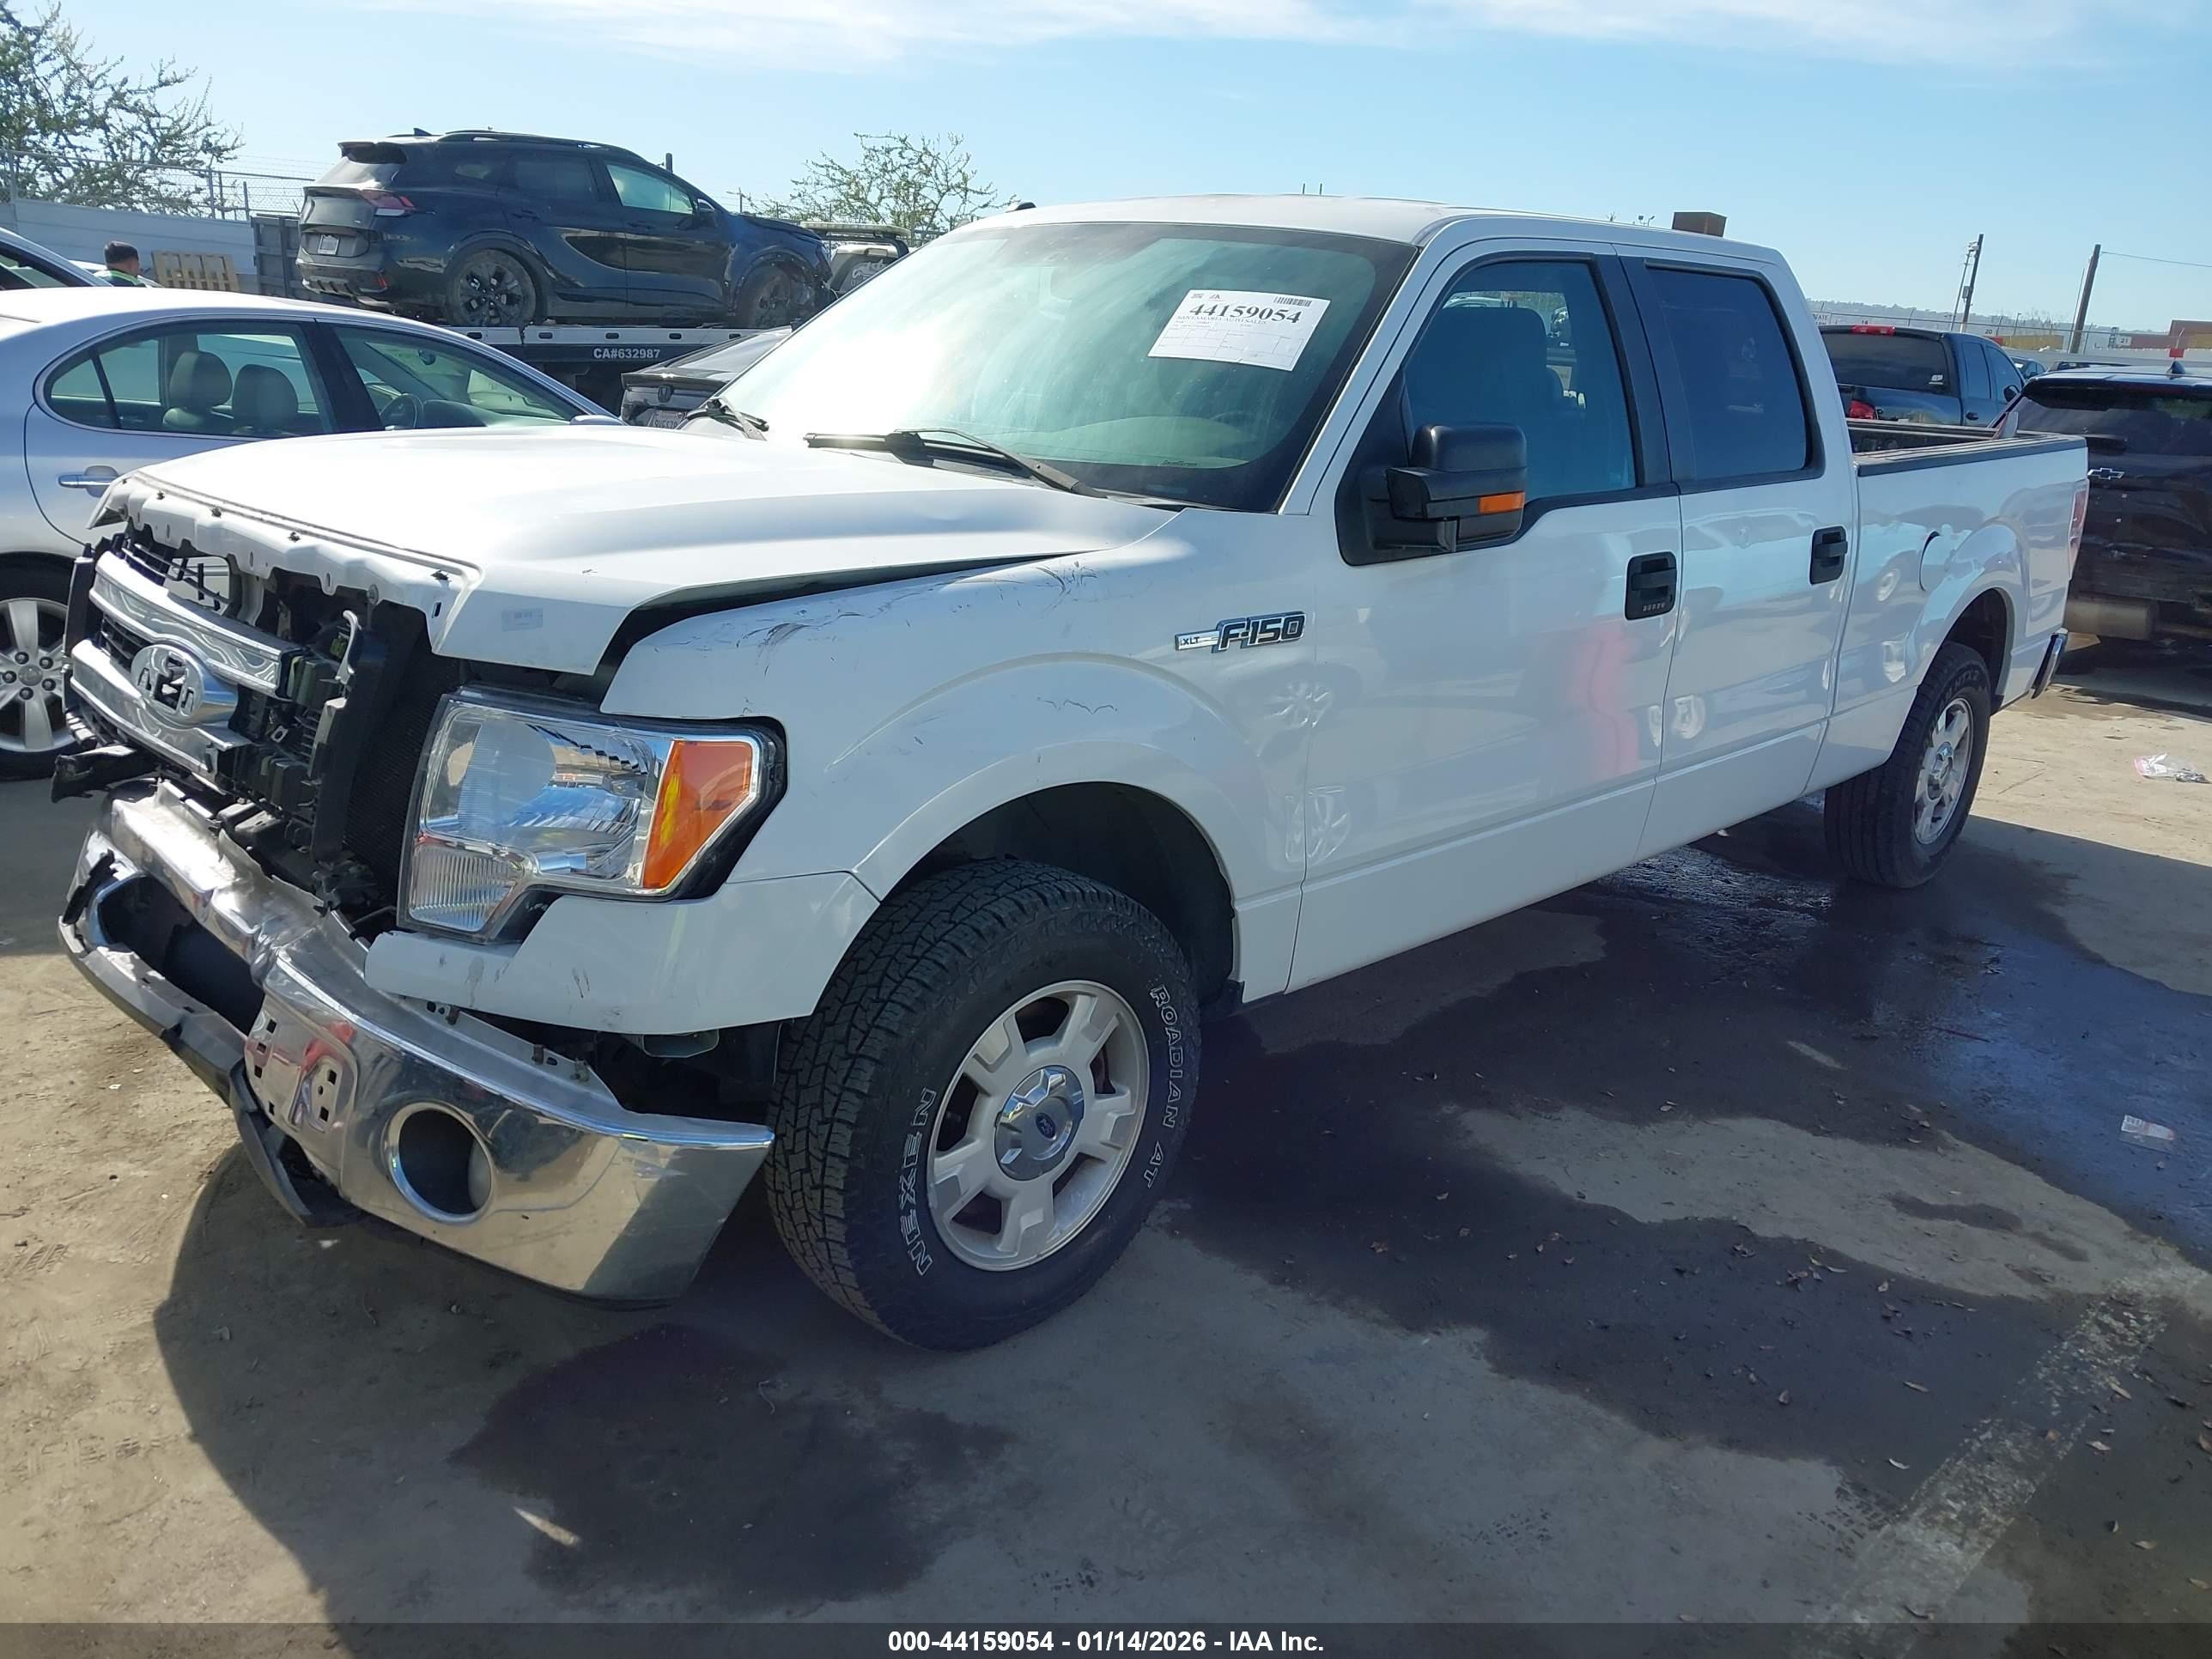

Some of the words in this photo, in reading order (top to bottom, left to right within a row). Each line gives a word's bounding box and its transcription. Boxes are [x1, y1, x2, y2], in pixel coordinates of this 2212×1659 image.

[1189, 303, 1303, 324] 44159054
[592, 348, 660, 359] CA#632987
[1182, 636, 1200, 646] XLT
[1212, 611, 1307, 653] F-150
[1150, 984, 1184, 1128] ROADIAN
[898, 1087, 938, 1277] NEXEN
[1143, 1140, 1164, 1188] AT
